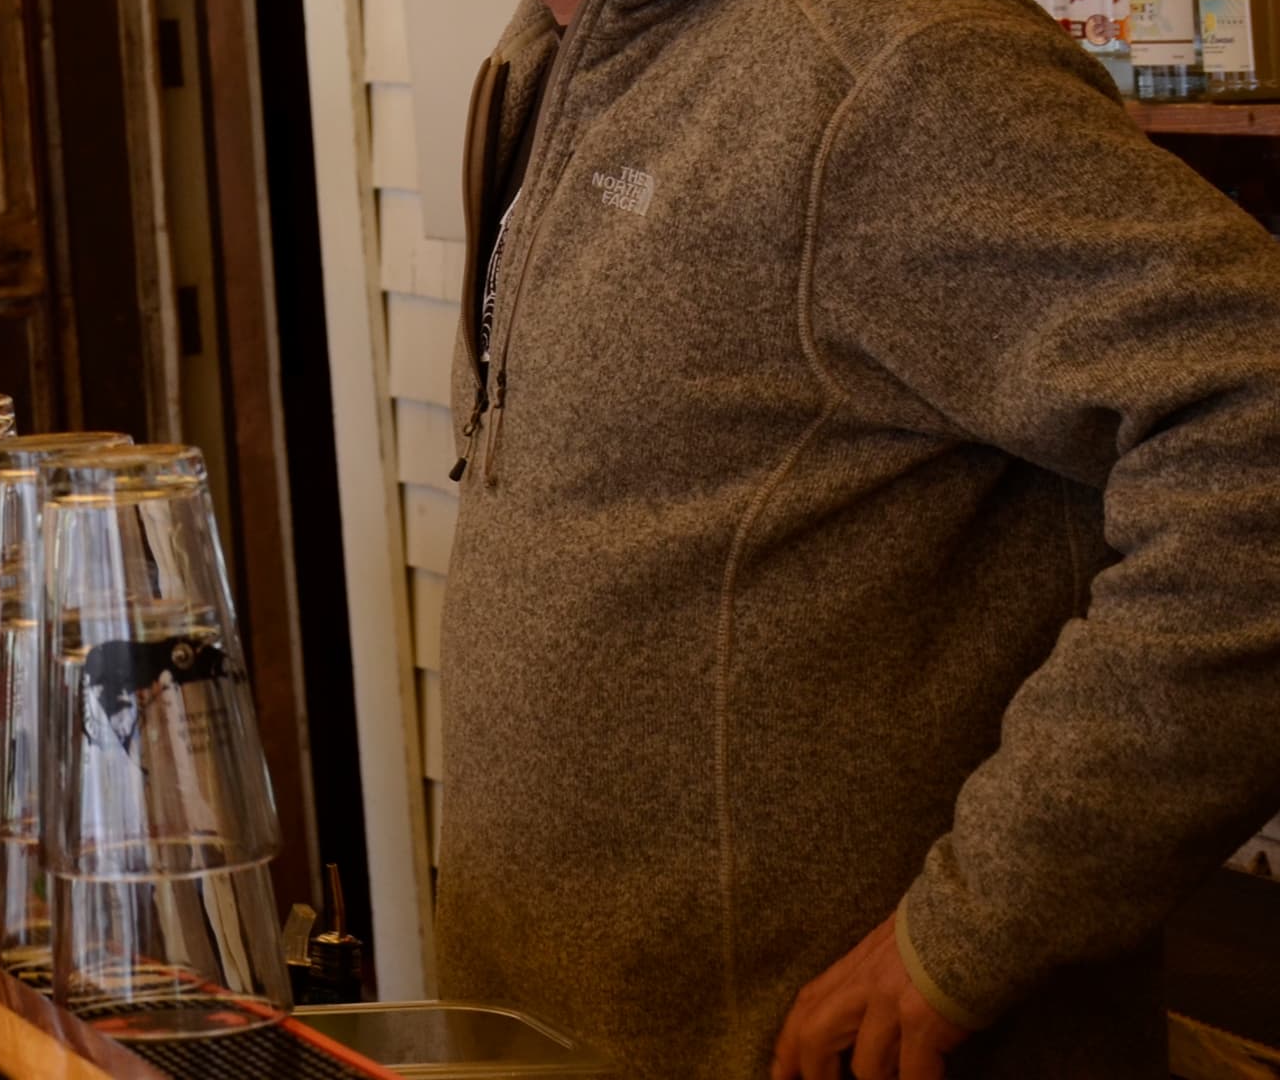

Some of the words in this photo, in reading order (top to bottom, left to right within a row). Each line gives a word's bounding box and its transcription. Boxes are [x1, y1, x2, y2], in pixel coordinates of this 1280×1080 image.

[591, 172, 645, 200] NORTH
[621, 167, 646, 186] THE
[601, 190, 638, 212] FACE
